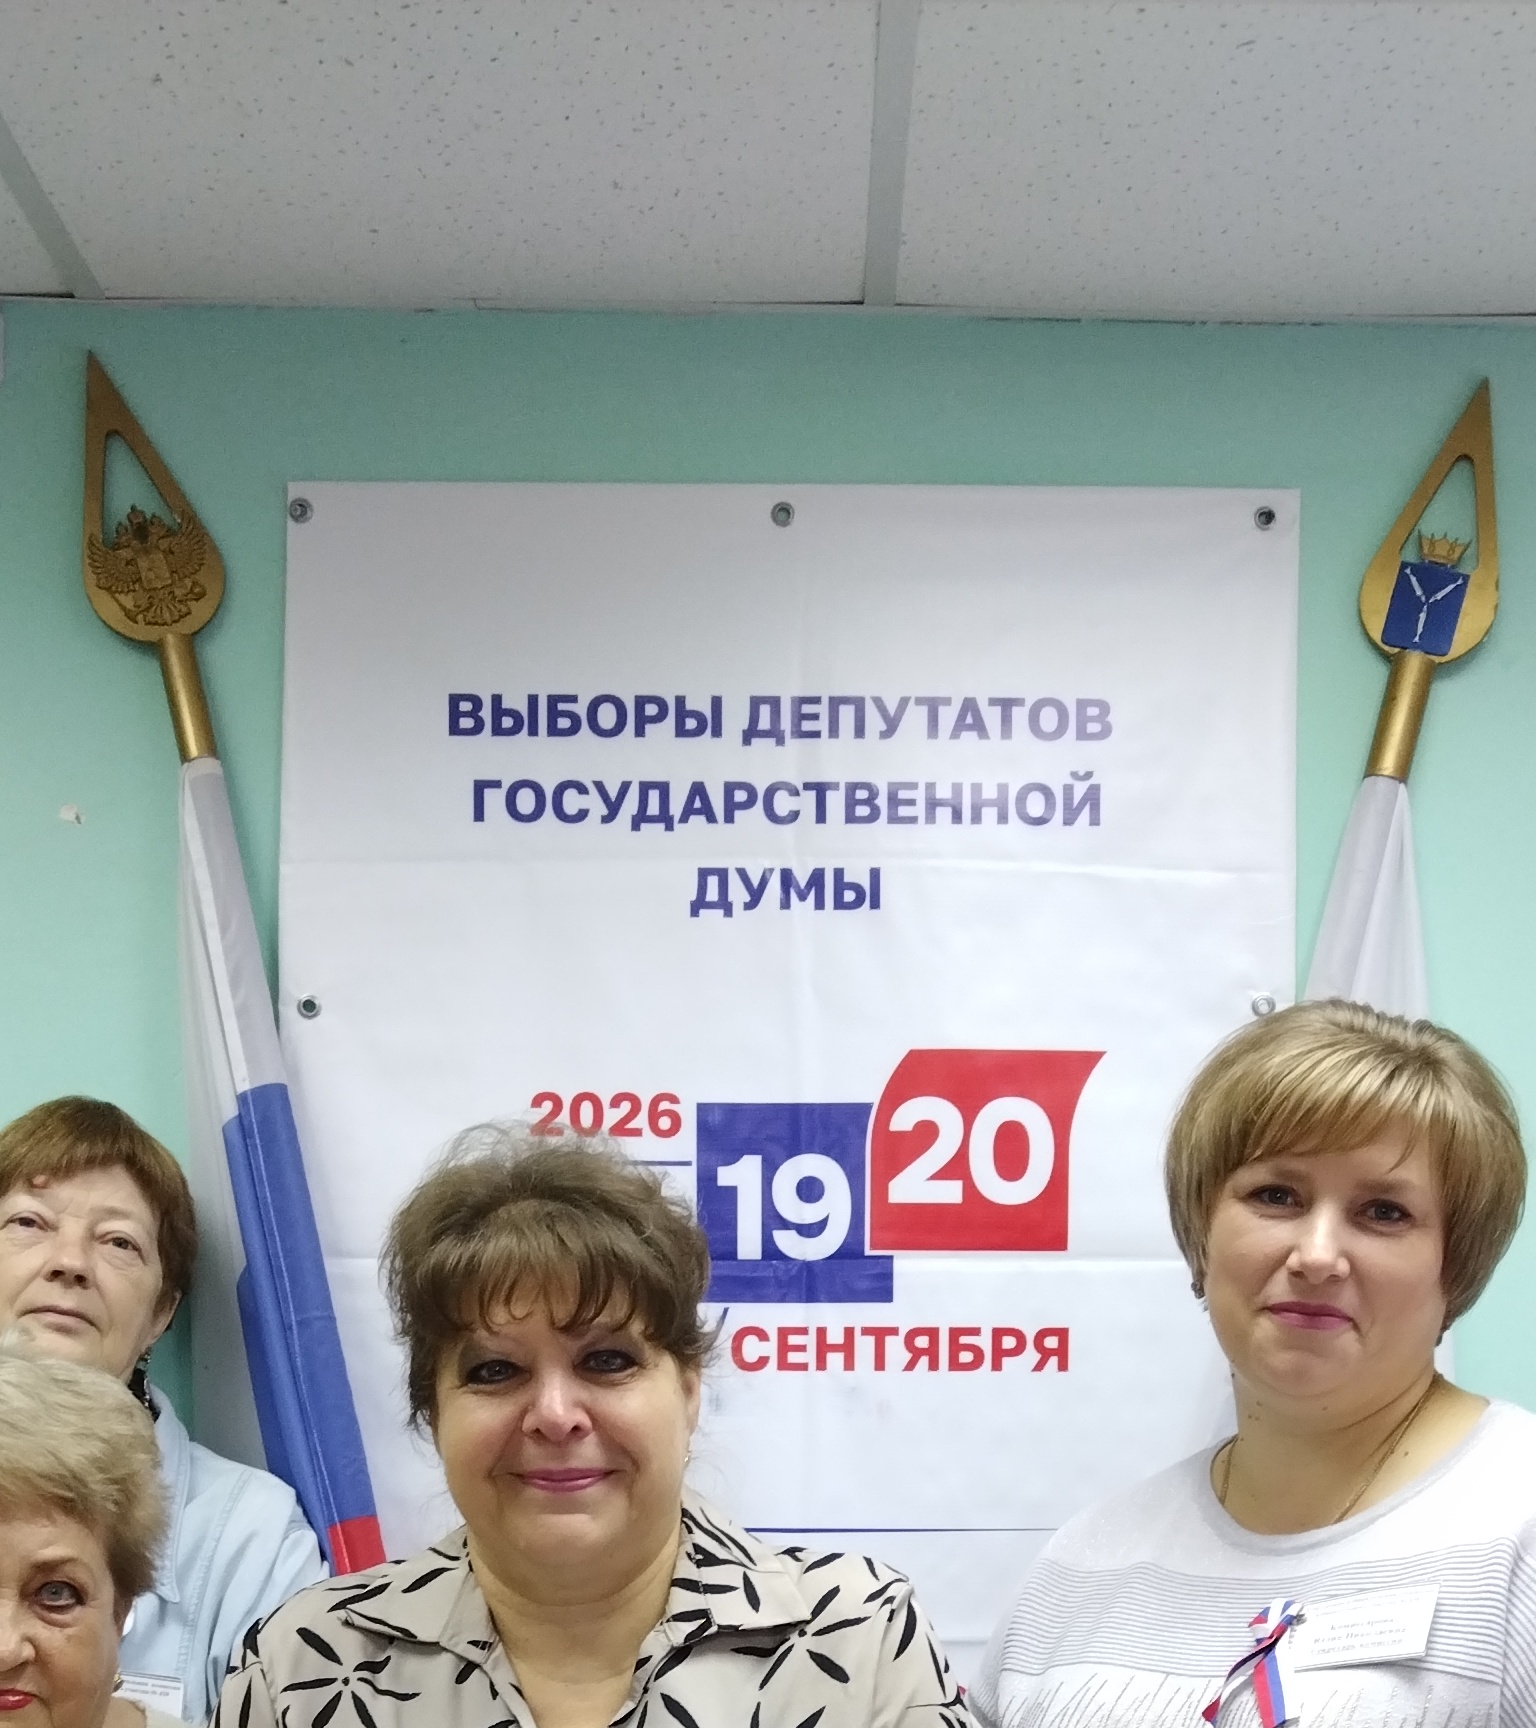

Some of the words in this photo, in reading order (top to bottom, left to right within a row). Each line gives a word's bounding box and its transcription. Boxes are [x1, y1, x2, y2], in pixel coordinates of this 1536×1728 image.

[447, 693, 723, 740] ВЫБОРЫ
[742, 695, 1113, 748] ДЕПУТАТОВ
[472, 771, 1101, 832] ГОСУДАРСТВЕННОЙ
[689, 867, 882, 918] ДУМЫ
[530, 1092, 682, 1139] 2026
[887, 1096, 1055, 1206] 20
[716, 1153, 852, 1261] 19
[730, 1326, 1070, 1373] СЕНТЯБРЯ
